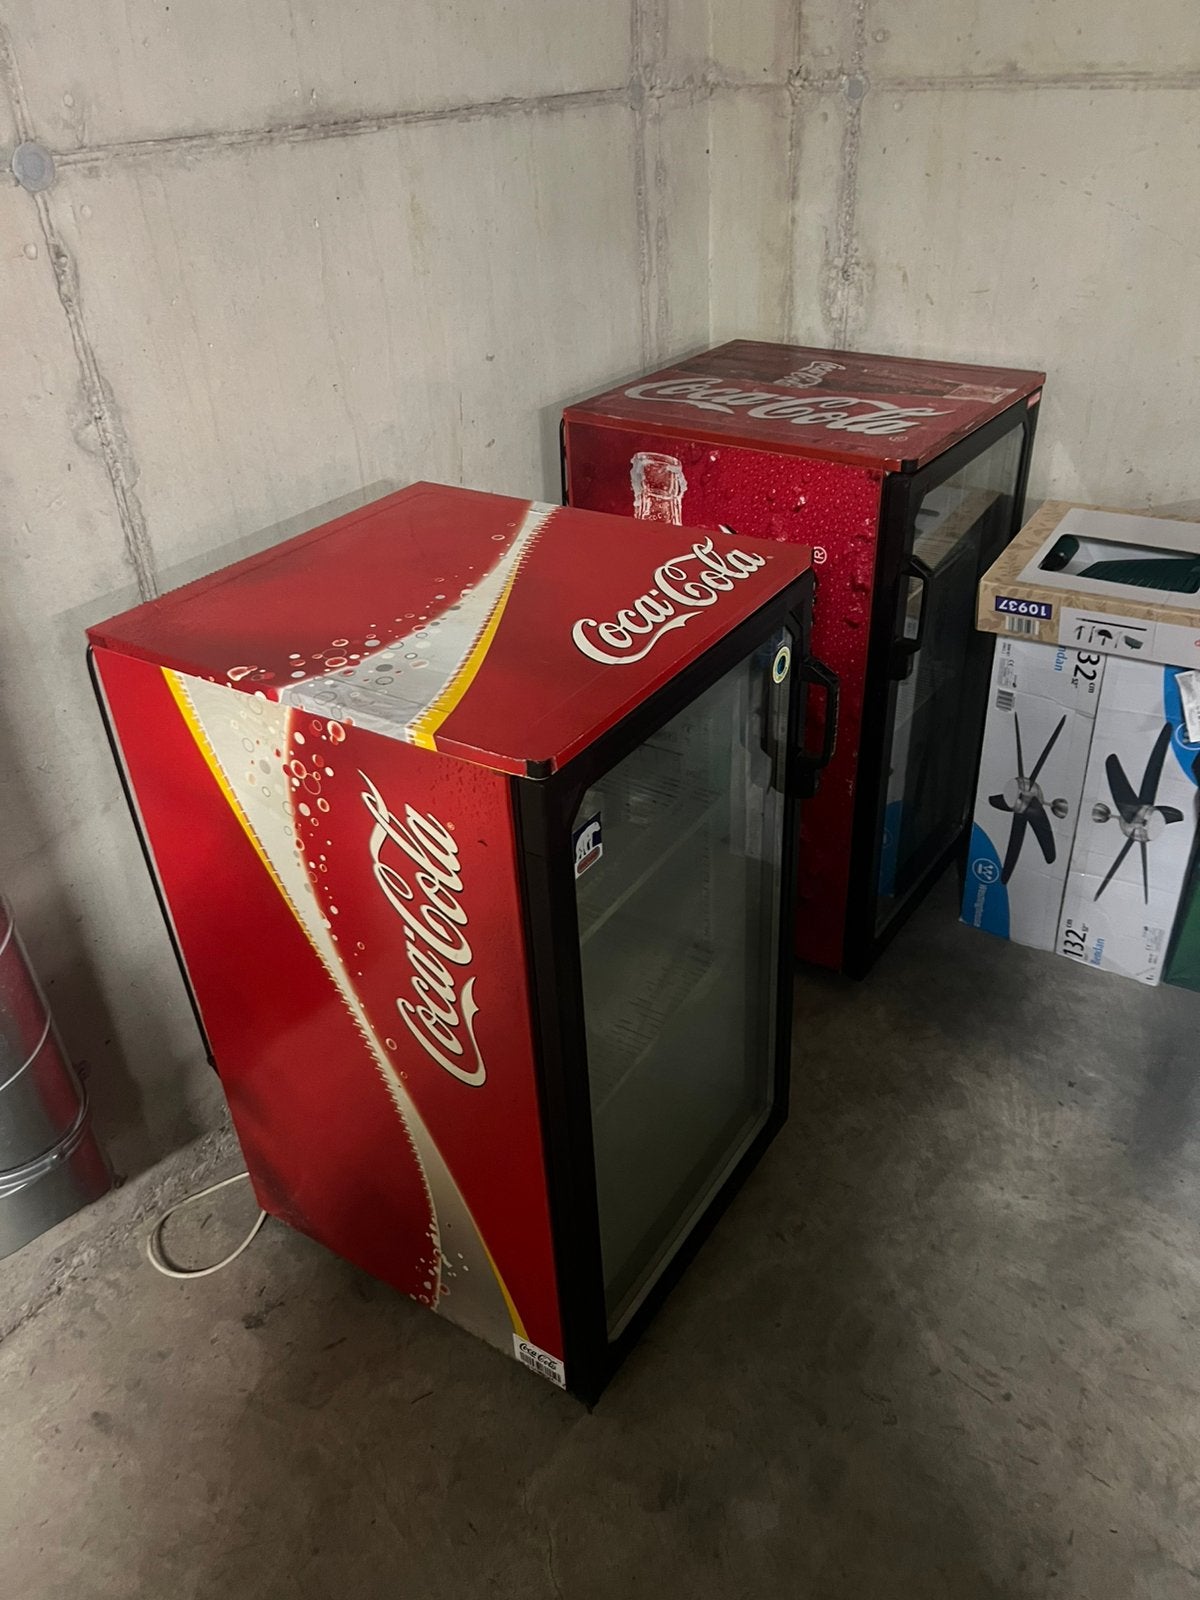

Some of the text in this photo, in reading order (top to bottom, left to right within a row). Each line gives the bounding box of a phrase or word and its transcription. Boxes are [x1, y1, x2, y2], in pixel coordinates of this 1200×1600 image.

[624, 378, 955, 435] Coca-Cola
[572, 535, 767, 665] Coca-Cola
[998, 599, 1047, 616] 10937
[1054, 646, 1068, 672] ndan
[1073, 651, 1100, 681] 32
[357, 768, 487, 1087] Coca-Cola
[1063, 929, 1087, 958] 132
